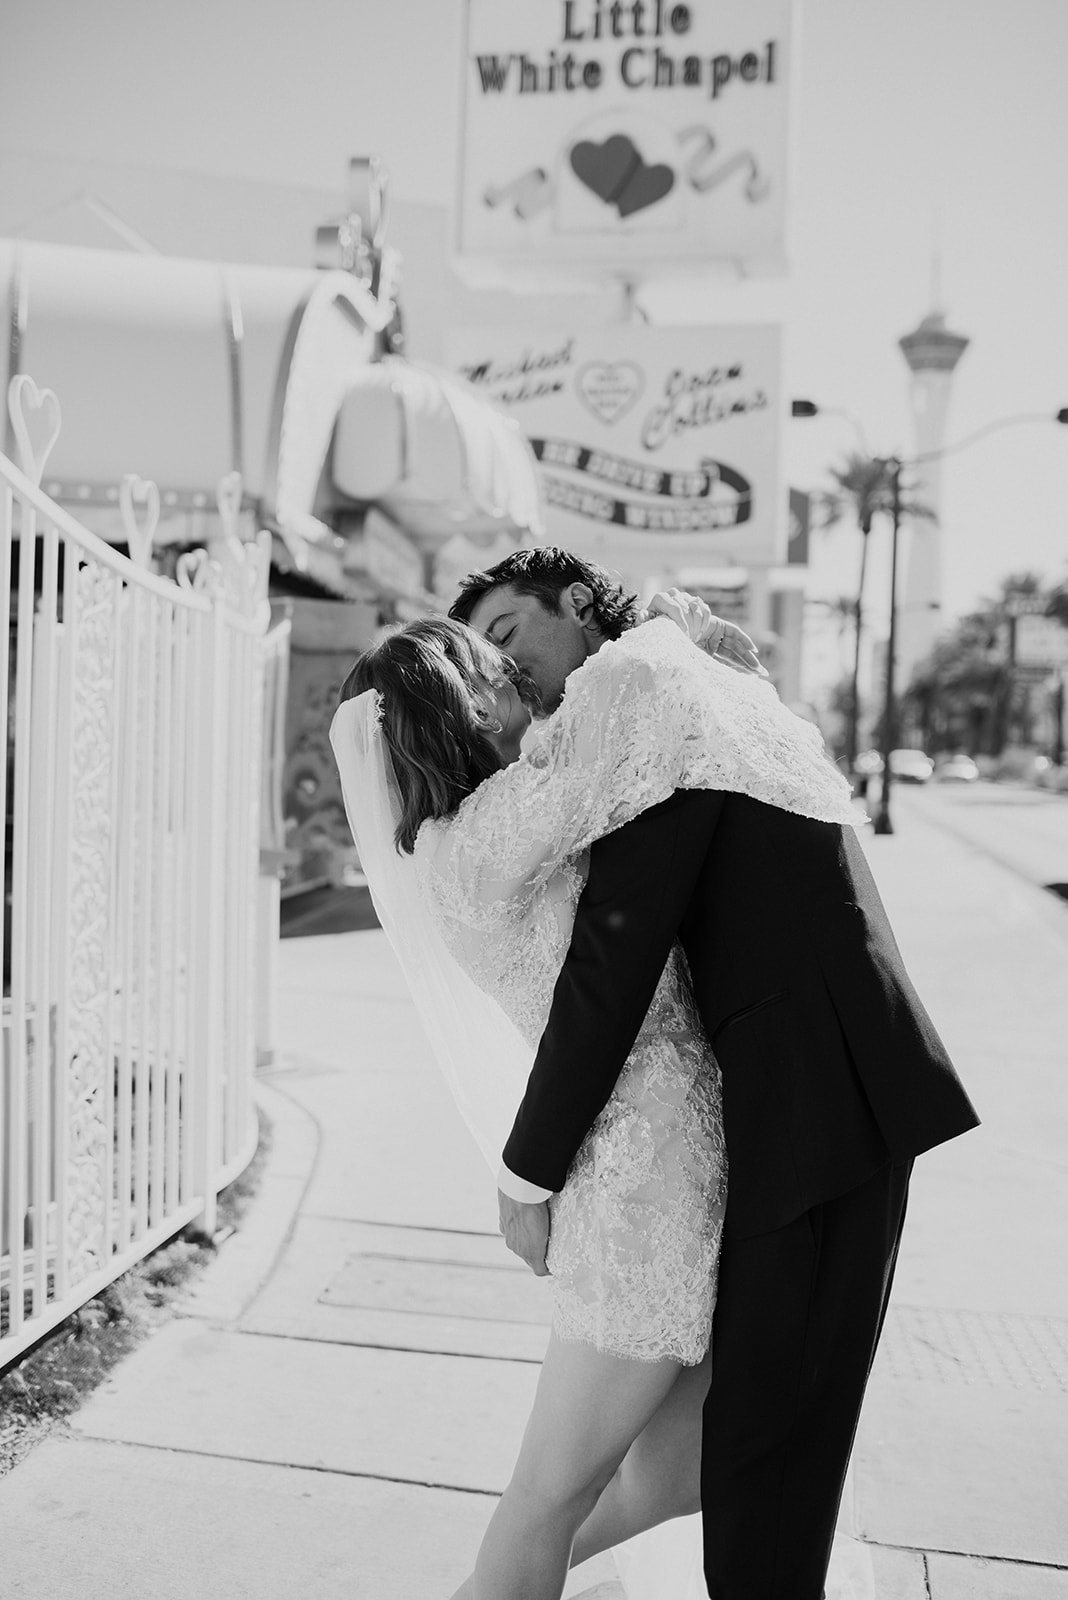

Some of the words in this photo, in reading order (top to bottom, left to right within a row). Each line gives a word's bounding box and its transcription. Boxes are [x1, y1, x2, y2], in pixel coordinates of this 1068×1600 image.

[563, 0, 692, 41] Little
[475, 51, 603, 95] White
[620, 41, 777, 101] Chapel
[586, 451, 664, 496] DRIVE
[669, 471, 708, 497] UP
[624, 500, 739, 531] WINDOW
